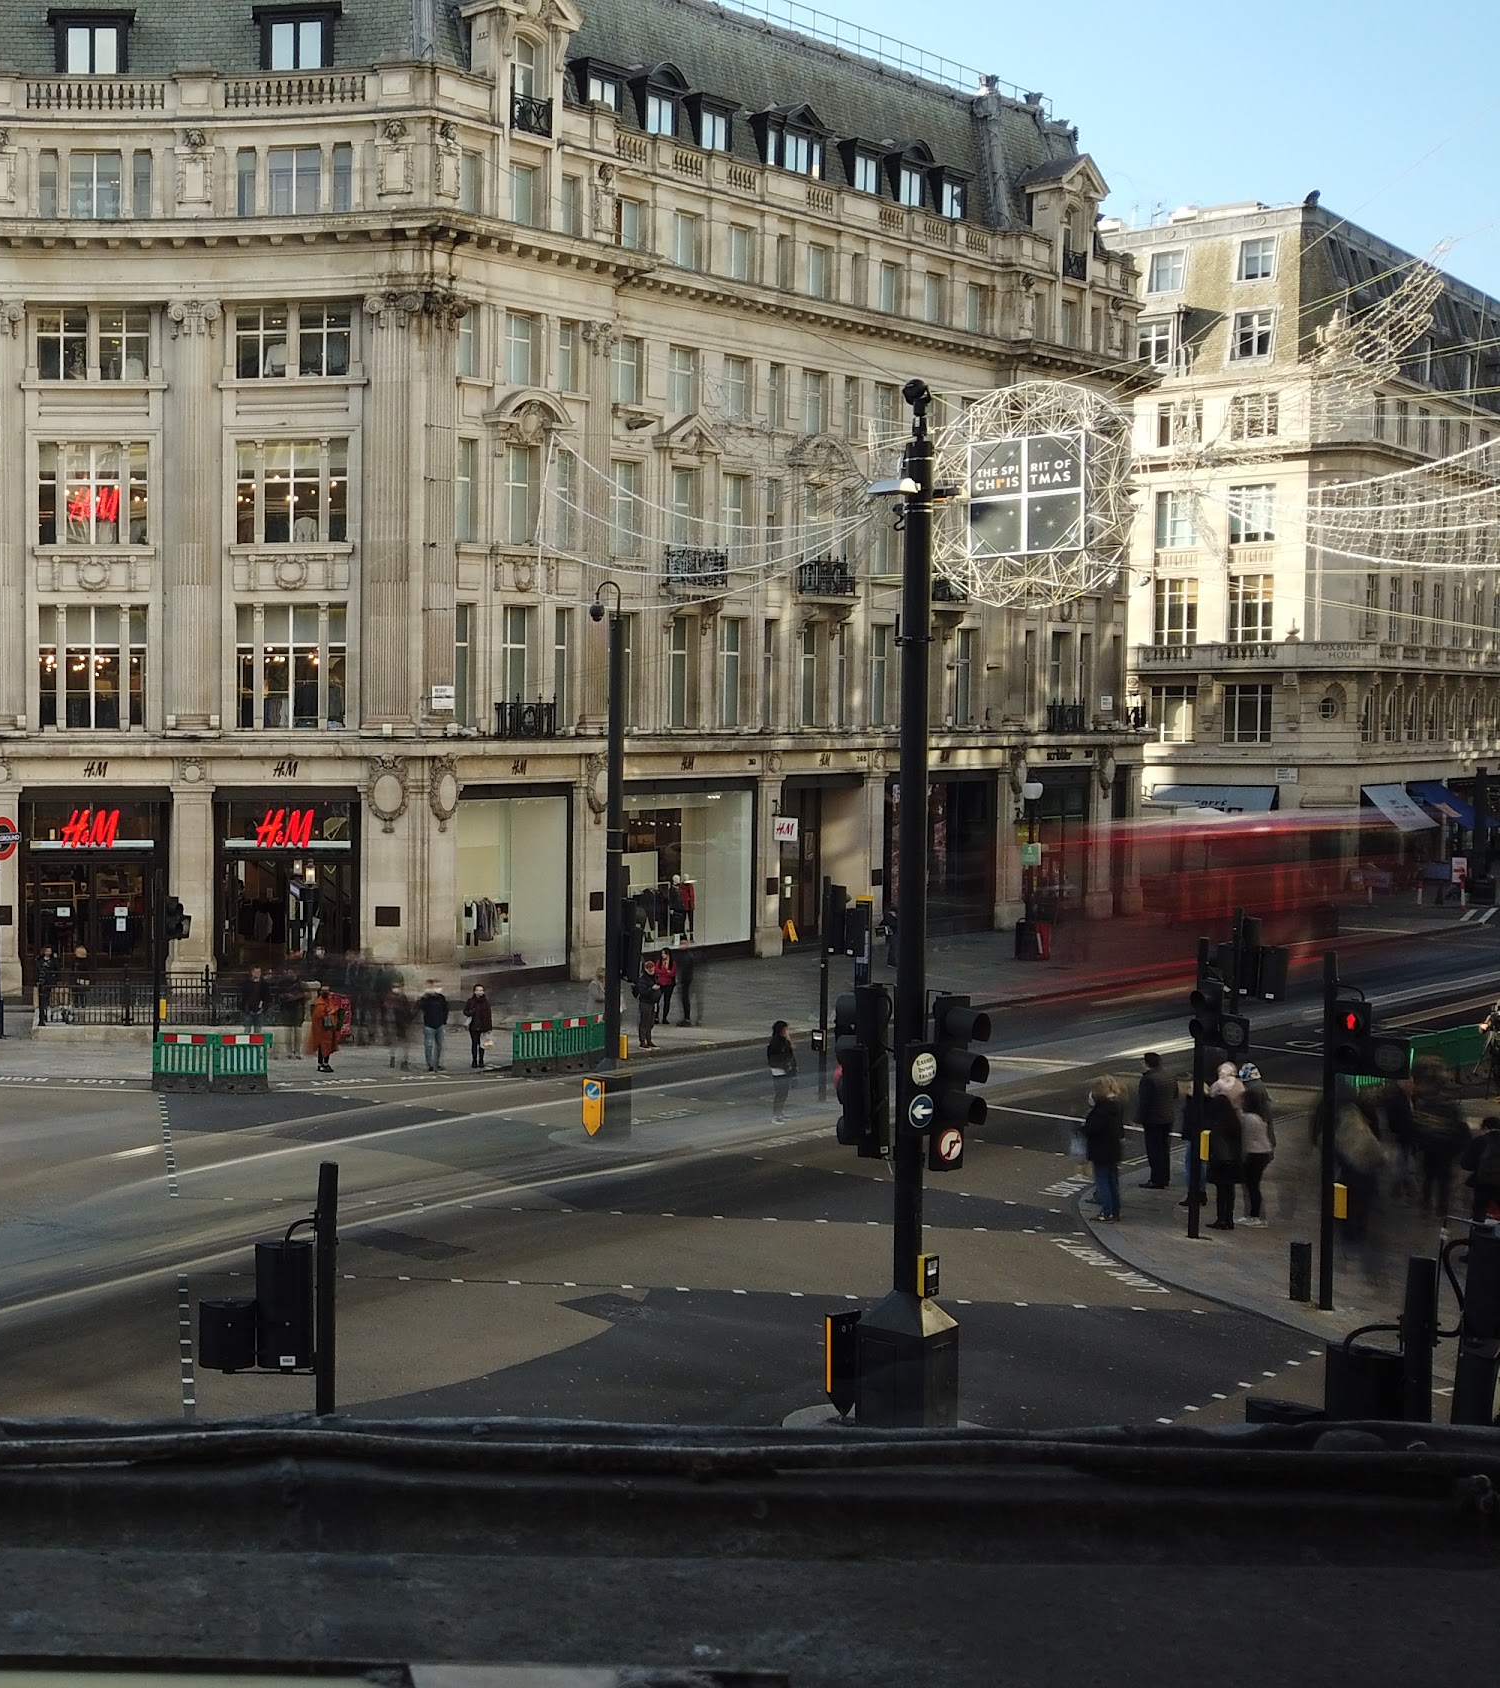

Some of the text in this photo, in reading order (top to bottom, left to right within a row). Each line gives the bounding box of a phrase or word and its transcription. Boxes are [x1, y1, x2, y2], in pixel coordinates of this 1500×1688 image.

[976, 467, 999, 478] THE
[1054, 459, 1071, 470] OF
[1328, 651, 1361, 659] HOUSE
[83, 761, 109, 778] H&M
[272, 760, 299, 778] H&M
[511, 759, 528, 776] H&M
[61, 809, 120, 848] H&M
[255, 809, 315, 849] H&M
[776, 823, 795, 836] H&M
[1104, 1270, 1171, 1294] LOOK
